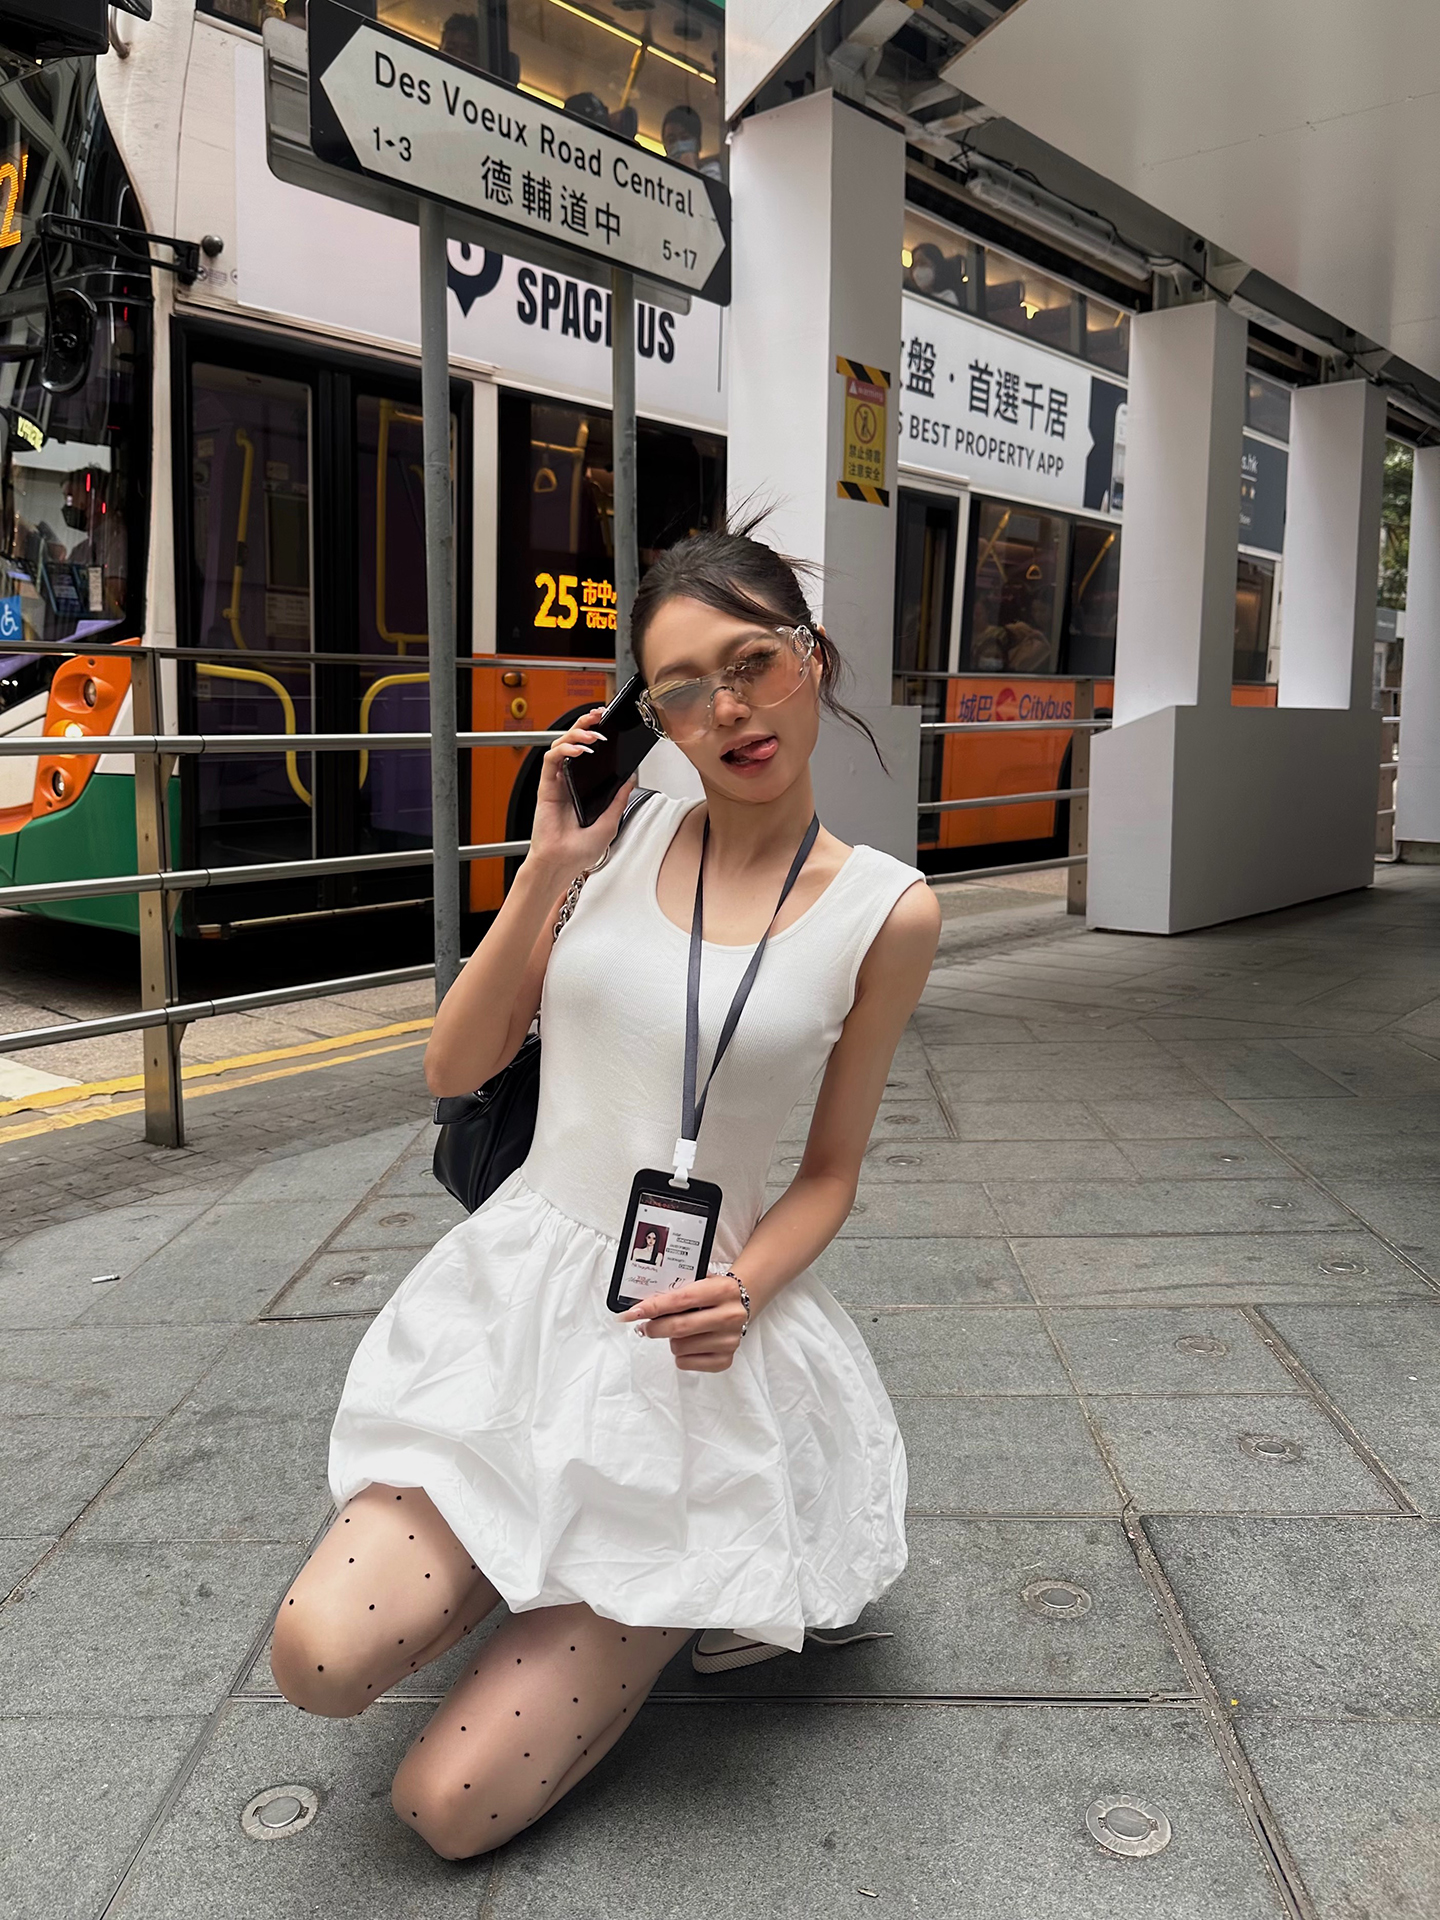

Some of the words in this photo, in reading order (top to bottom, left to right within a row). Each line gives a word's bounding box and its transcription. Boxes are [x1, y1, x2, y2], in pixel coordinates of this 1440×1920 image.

[375, 50, 431, 105] Des
[442, 80, 528, 147] Voeux
[540, 123, 602, 178] Road
[613, 157, 694, 217] Central
[480, 155, 621, 245] 德輔道中
[858, 386, 884, 403] warning
[910, 414, 950, 448] BEST
[955, 428, 1034, 469] PROPERTY
[1036, 452, 1064, 478] APP
[848, 462, 880, 482] 注意安全
[534, 573, 578, 629] 25
[958, 694, 993, 723] 城巴
[1018, 694, 1072, 721] Citybus
